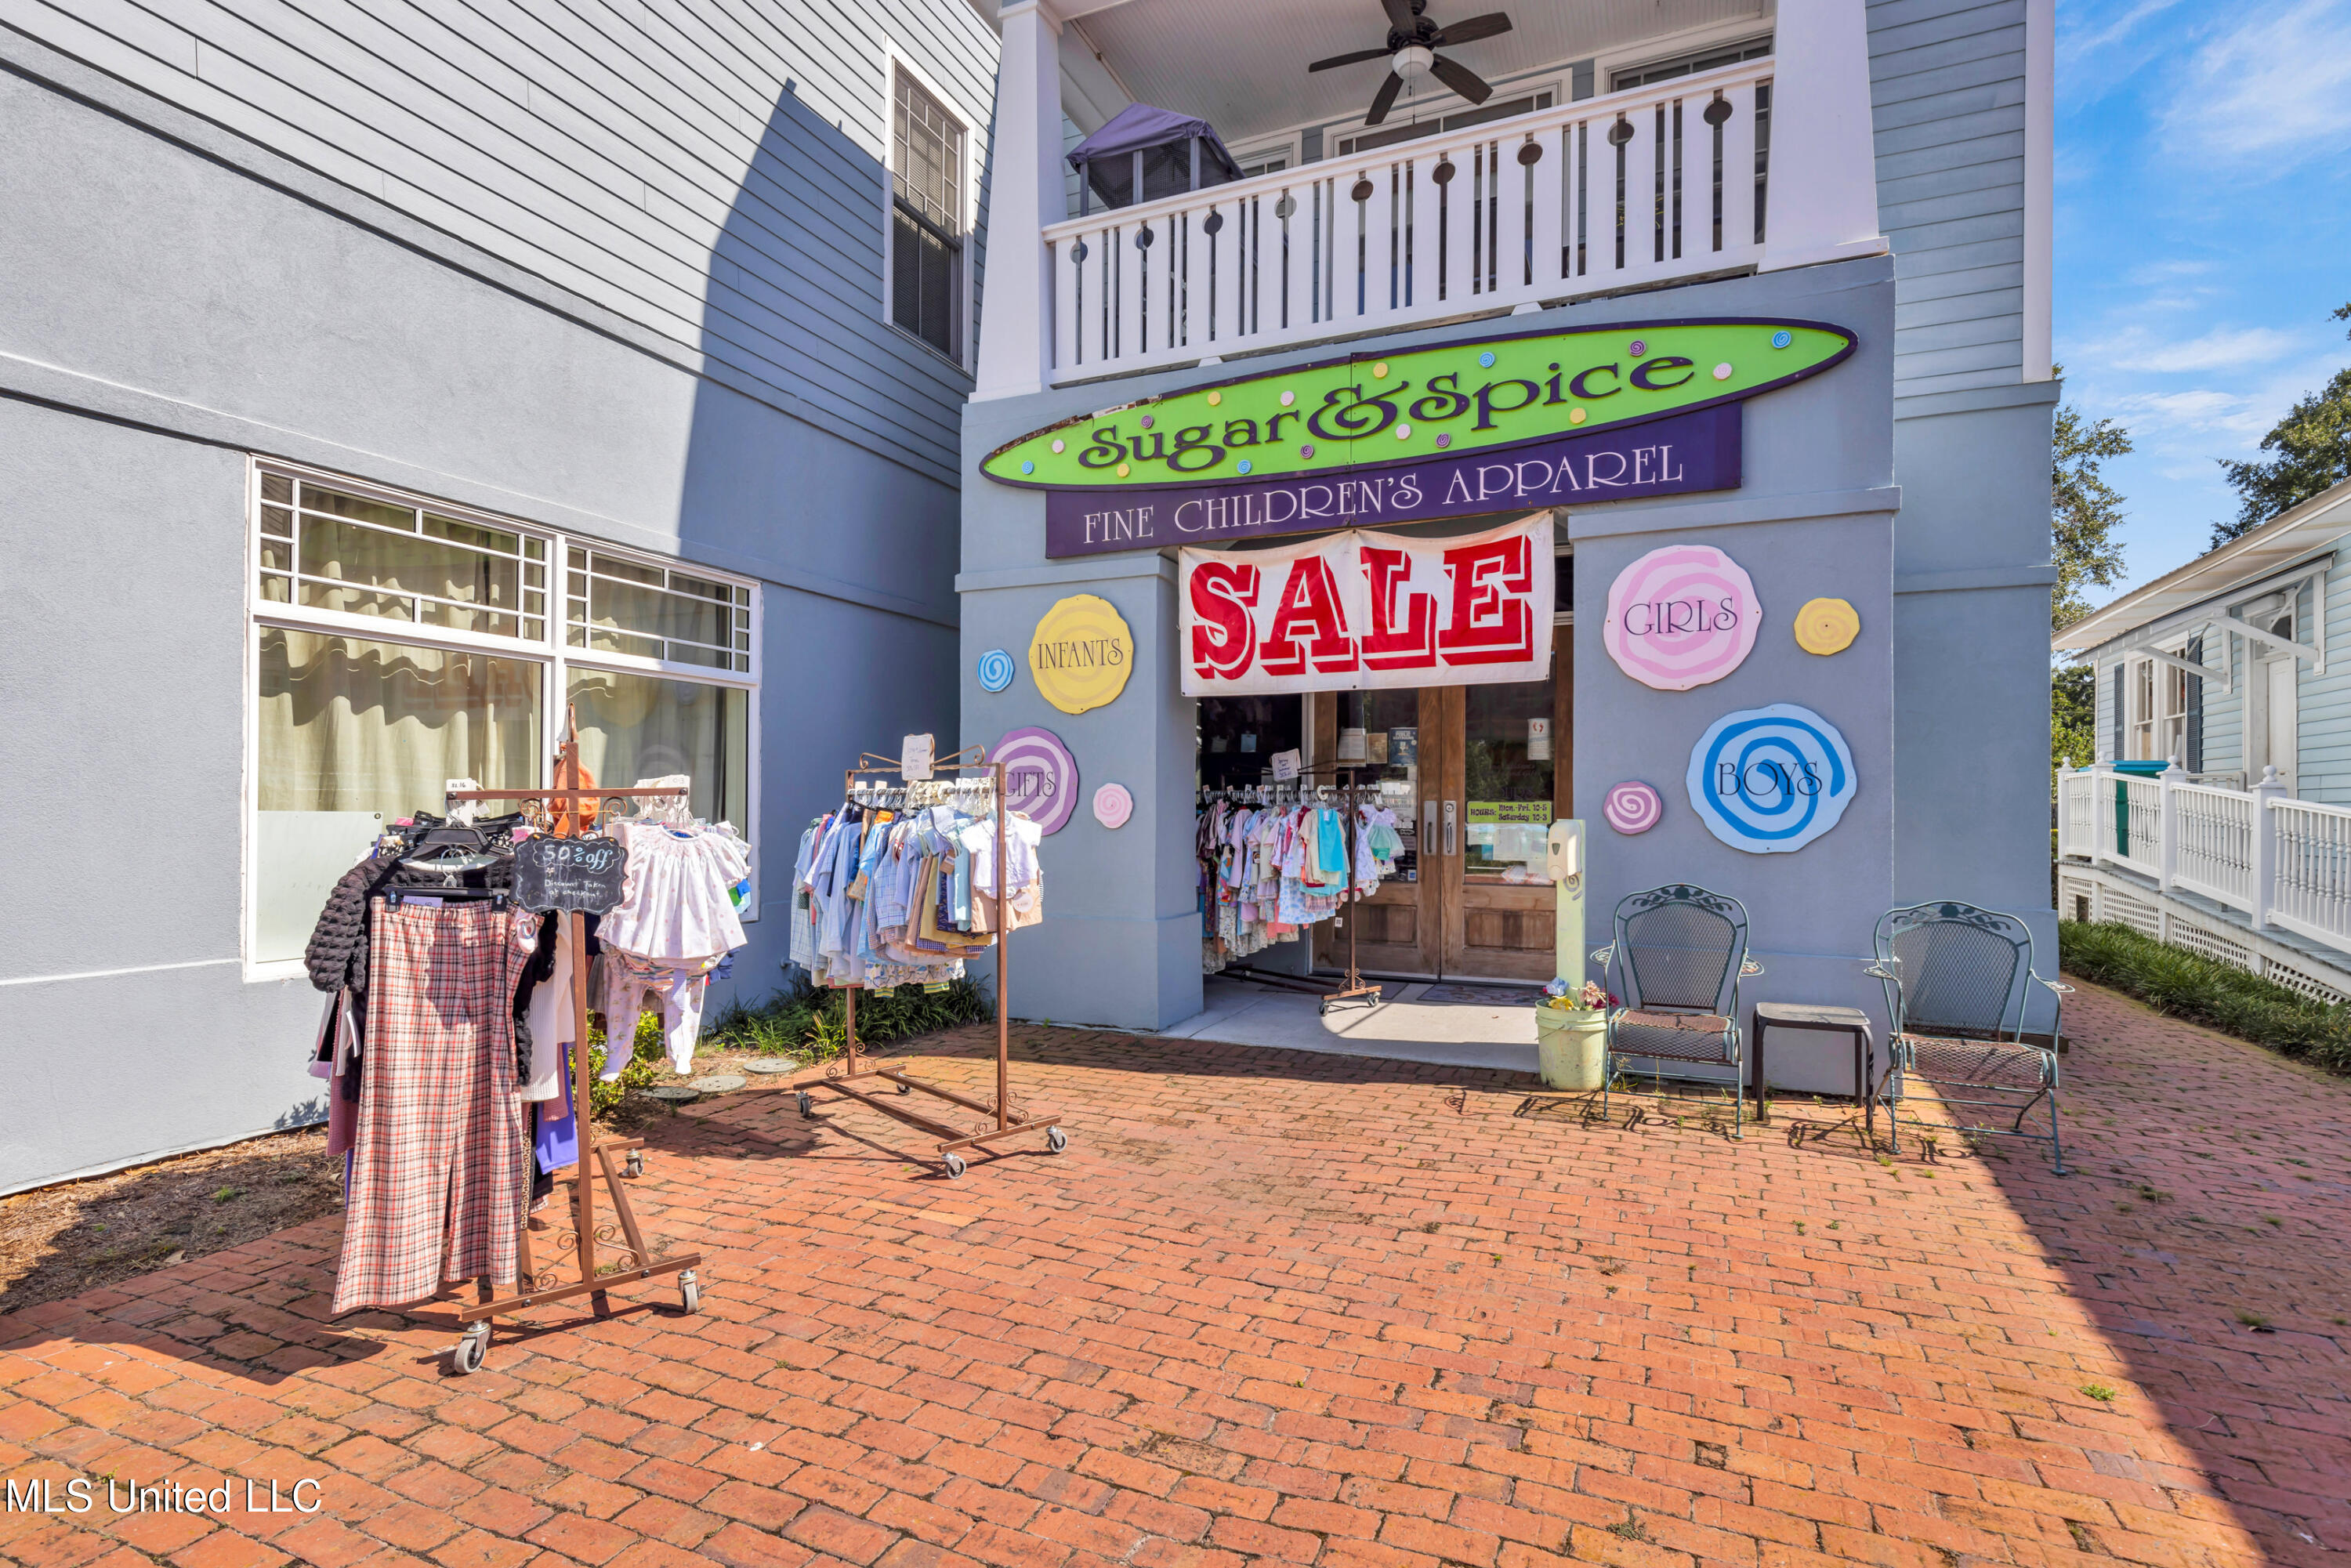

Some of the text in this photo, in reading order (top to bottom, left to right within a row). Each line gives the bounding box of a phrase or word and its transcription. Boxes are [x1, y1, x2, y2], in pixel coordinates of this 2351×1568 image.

[1078, 409, 1300, 473] Sugar
[1408, 356, 1695, 432] Spice
[1083, 444, 1683, 545] FINE CHILDREN'S APPAREL
[1190, 534, 1534, 681] SALE
[1624, 596, 1738, 636] GIRLS
[1037, 638, 1124, 670] INFANTS
[1717, 760, 1823, 796] BOYS
[1470, 808, 1497, 817] HOURS:
[1498, 813, 1548, 822] Saturday 10-3
[1533, 803, 1548, 812] 10-5
[585, 849, 614, 870] off
[545, 878, 578, 888] Discount
